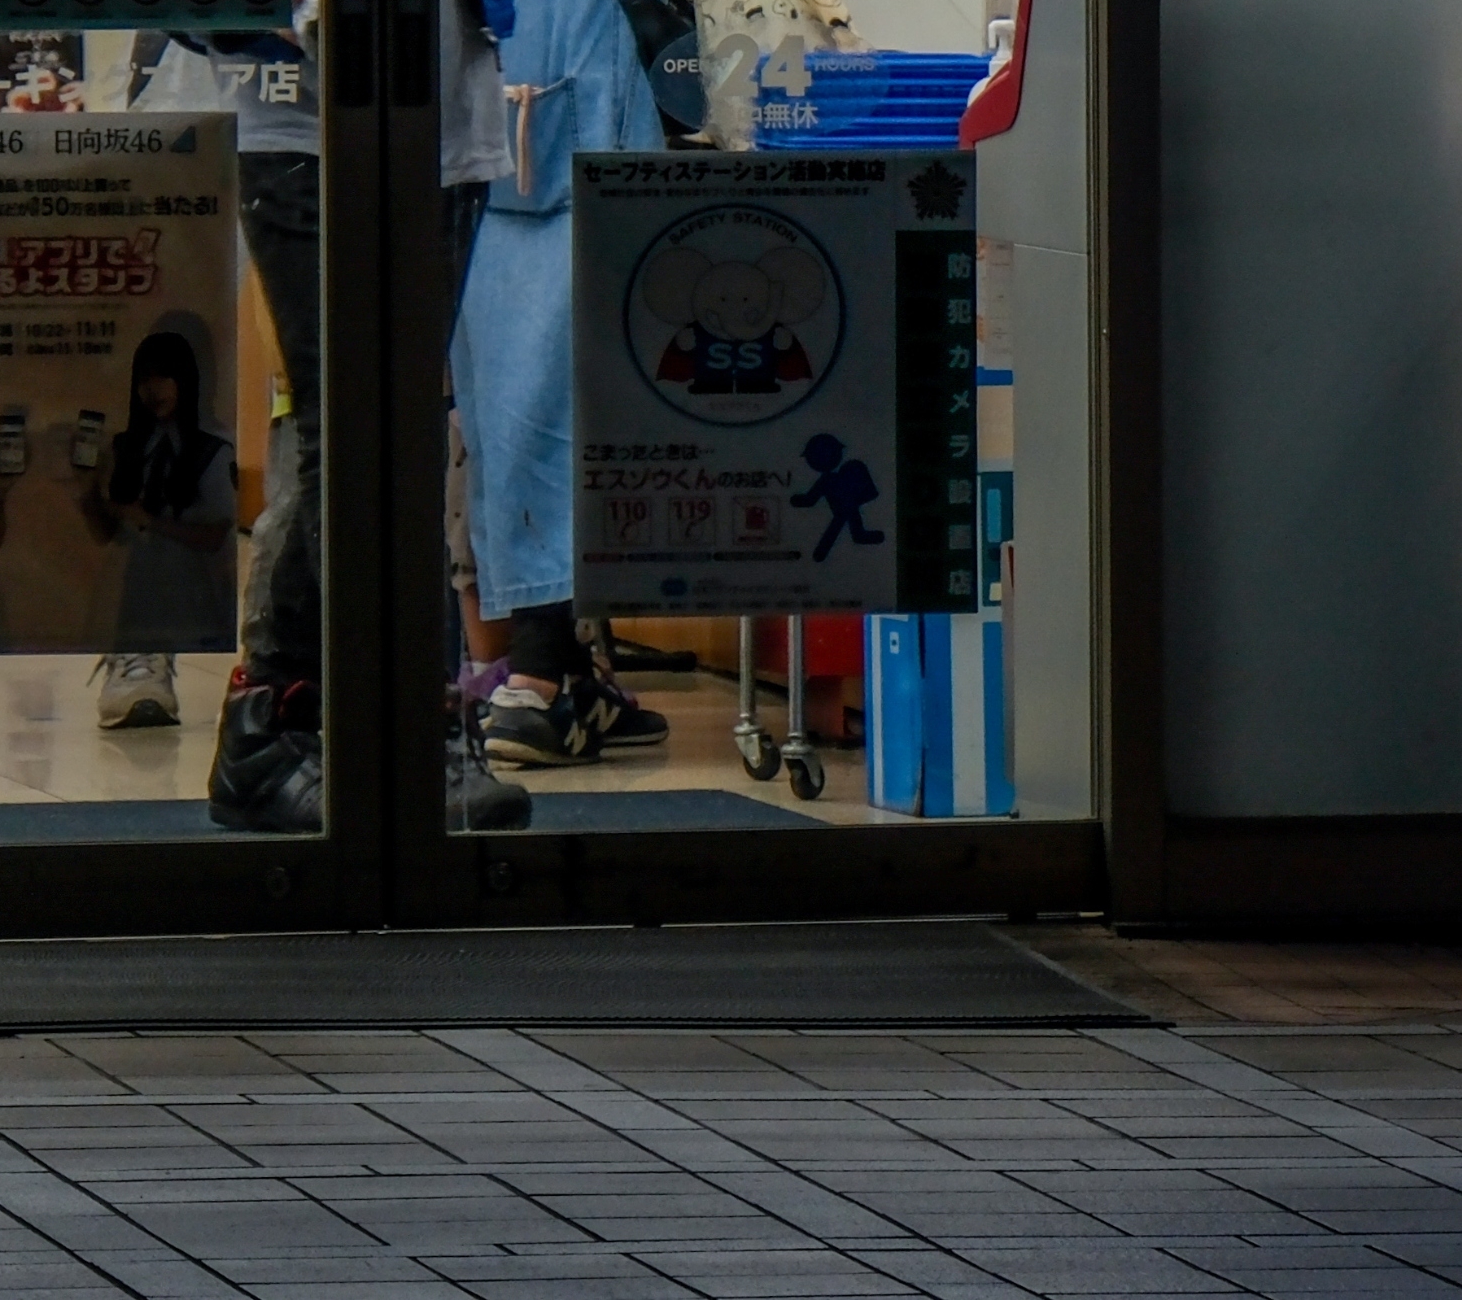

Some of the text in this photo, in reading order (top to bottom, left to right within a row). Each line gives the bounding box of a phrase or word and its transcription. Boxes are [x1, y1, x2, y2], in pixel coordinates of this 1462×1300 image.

[711, 33, 813, 98] 24
[814, 56, 877, 72] HOURS
[54, 128, 163, 154] 日向坂46
[668, 212, 798, 245] SAFETY STATION
[610, 500, 712, 521] 110 119
